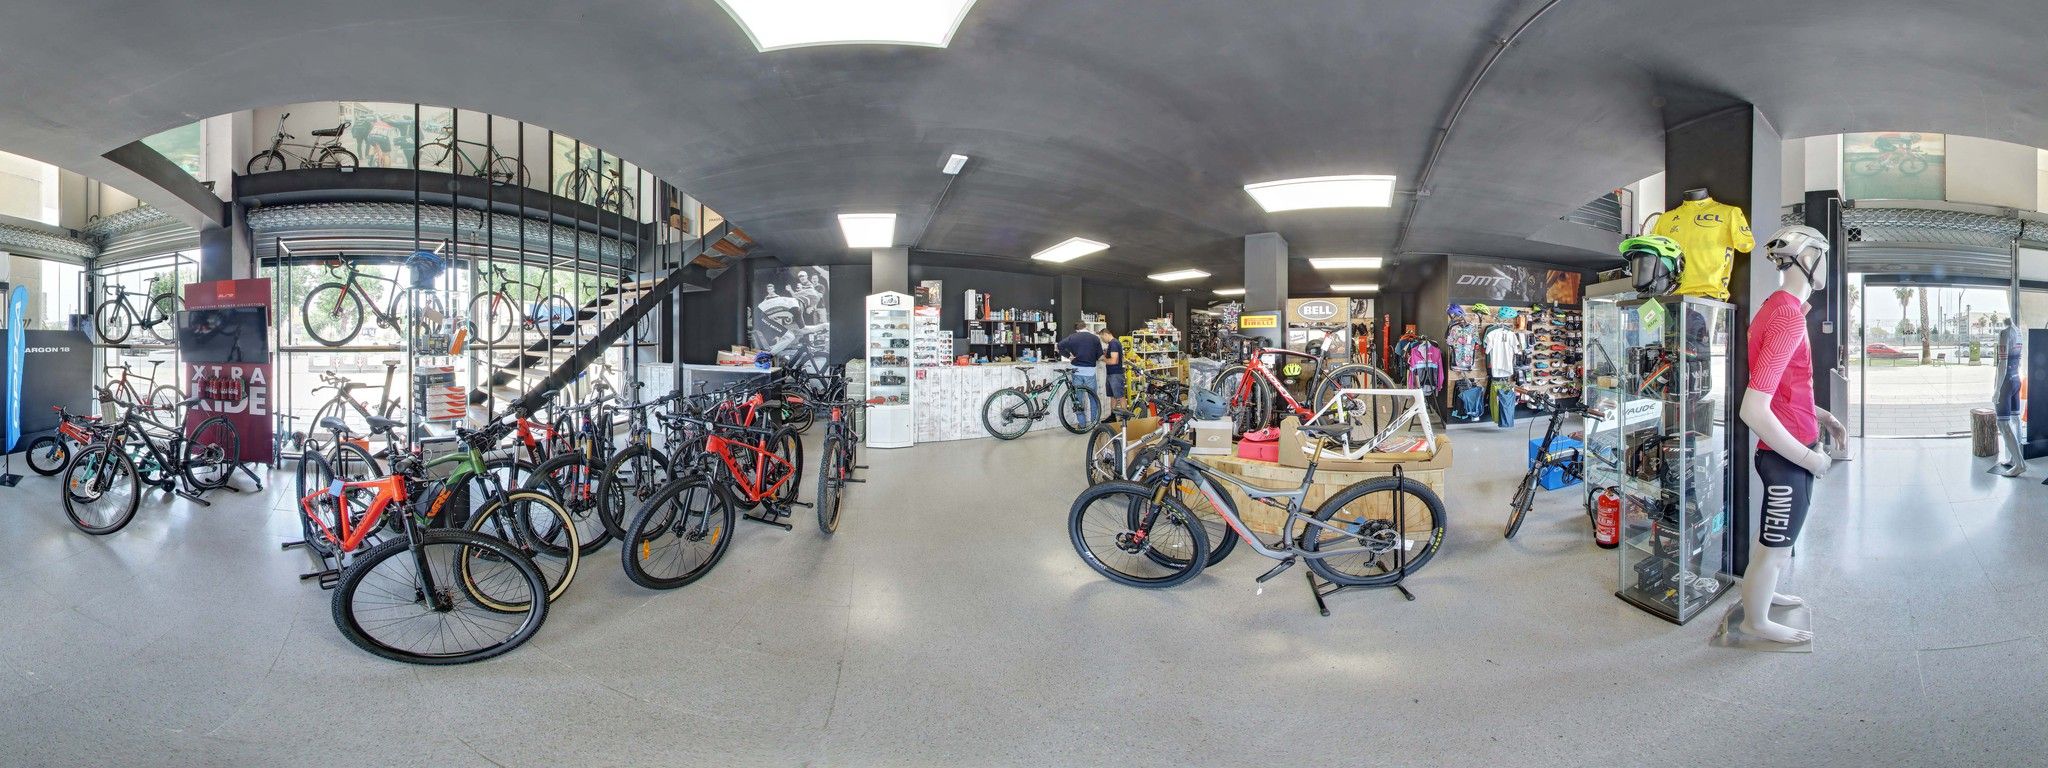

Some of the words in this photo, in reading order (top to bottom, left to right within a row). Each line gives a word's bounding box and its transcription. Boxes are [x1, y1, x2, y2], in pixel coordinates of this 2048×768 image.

[1695, 213, 1724, 223] LCL
[1456, 274, 1506, 287] DMT
[1303, 305, 1332, 315] BELL
[1243, 317, 1273, 326] PIRELLI
[191, 365, 266, 385] XTRA
[1764, 485, 1793, 543] ONVELÓ
